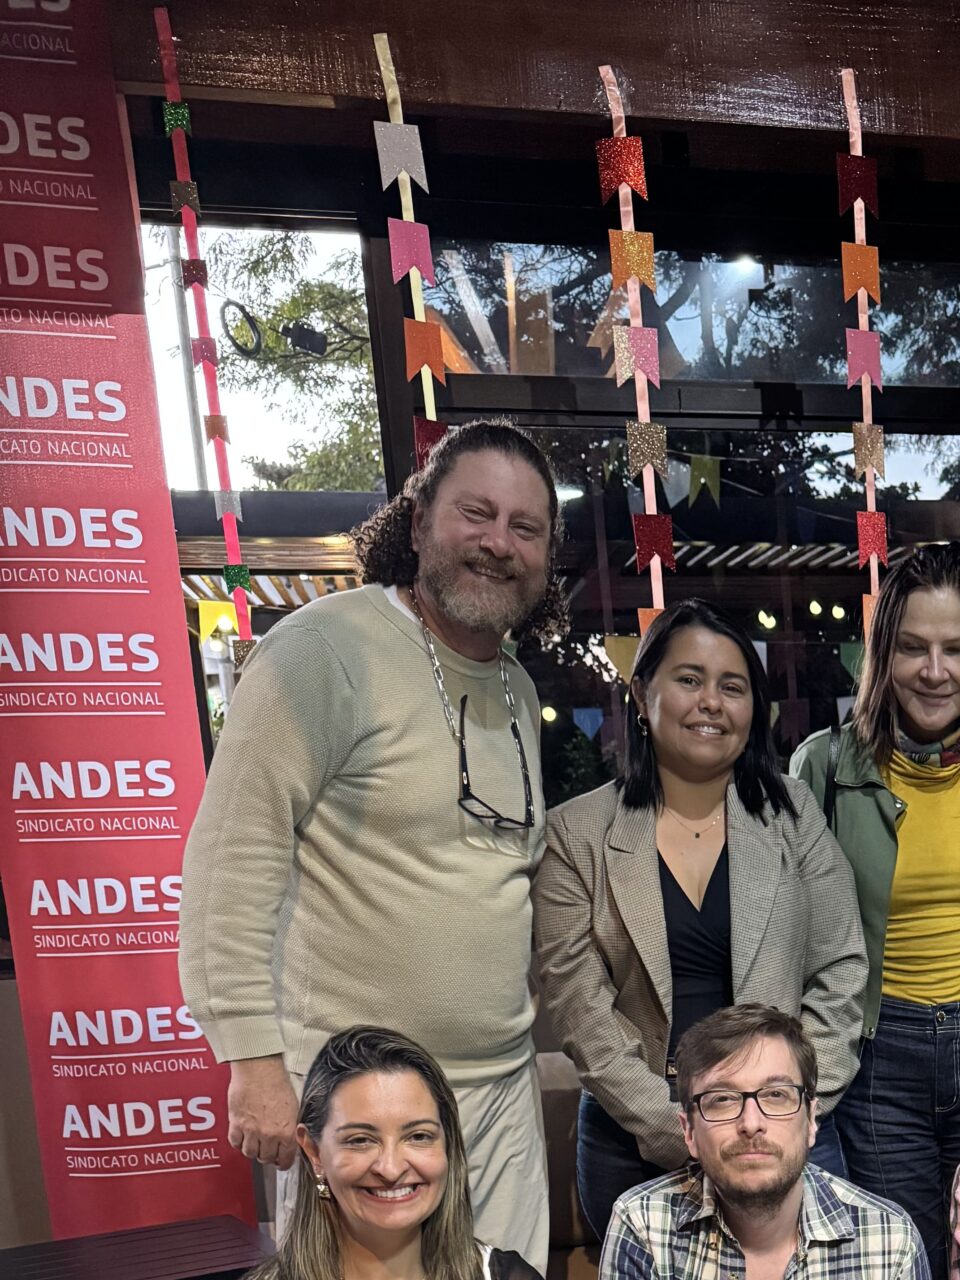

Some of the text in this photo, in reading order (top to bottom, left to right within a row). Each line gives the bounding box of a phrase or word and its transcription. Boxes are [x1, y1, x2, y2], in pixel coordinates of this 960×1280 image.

[0, 32, 75, 53] ACIONAL
[0, 111, 90, 160] DES
[9, 179, 97, 199] NACIONAL
[0, 243, 109, 291] DES
[28, 310, 115, 329] NACIONAL
[0, 376, 127, 422] NDES
[48, 441, 132, 458] NACIONAL
[0, 507, 143, 549] NDES
[65, 569, 149, 584] NACIONAL
[0, 633, 160, 672] ANDES
[83, 692, 165, 706] NACIONAL
[12, 760, 175, 800] ANDES
[16, 816, 180, 833] SINDICATO NACIONAL
[30, 875, 182, 916] ANDES
[34, 930, 180, 948] SINDICATO NACION
[49, 1005, 204, 1047] ANDES
[52, 1057, 209, 1077] SINDICATO NACIONAL
[62, 1096, 216, 1139] ANDES
[66, 1147, 220, 1169] SINDICATO NACIONAL
